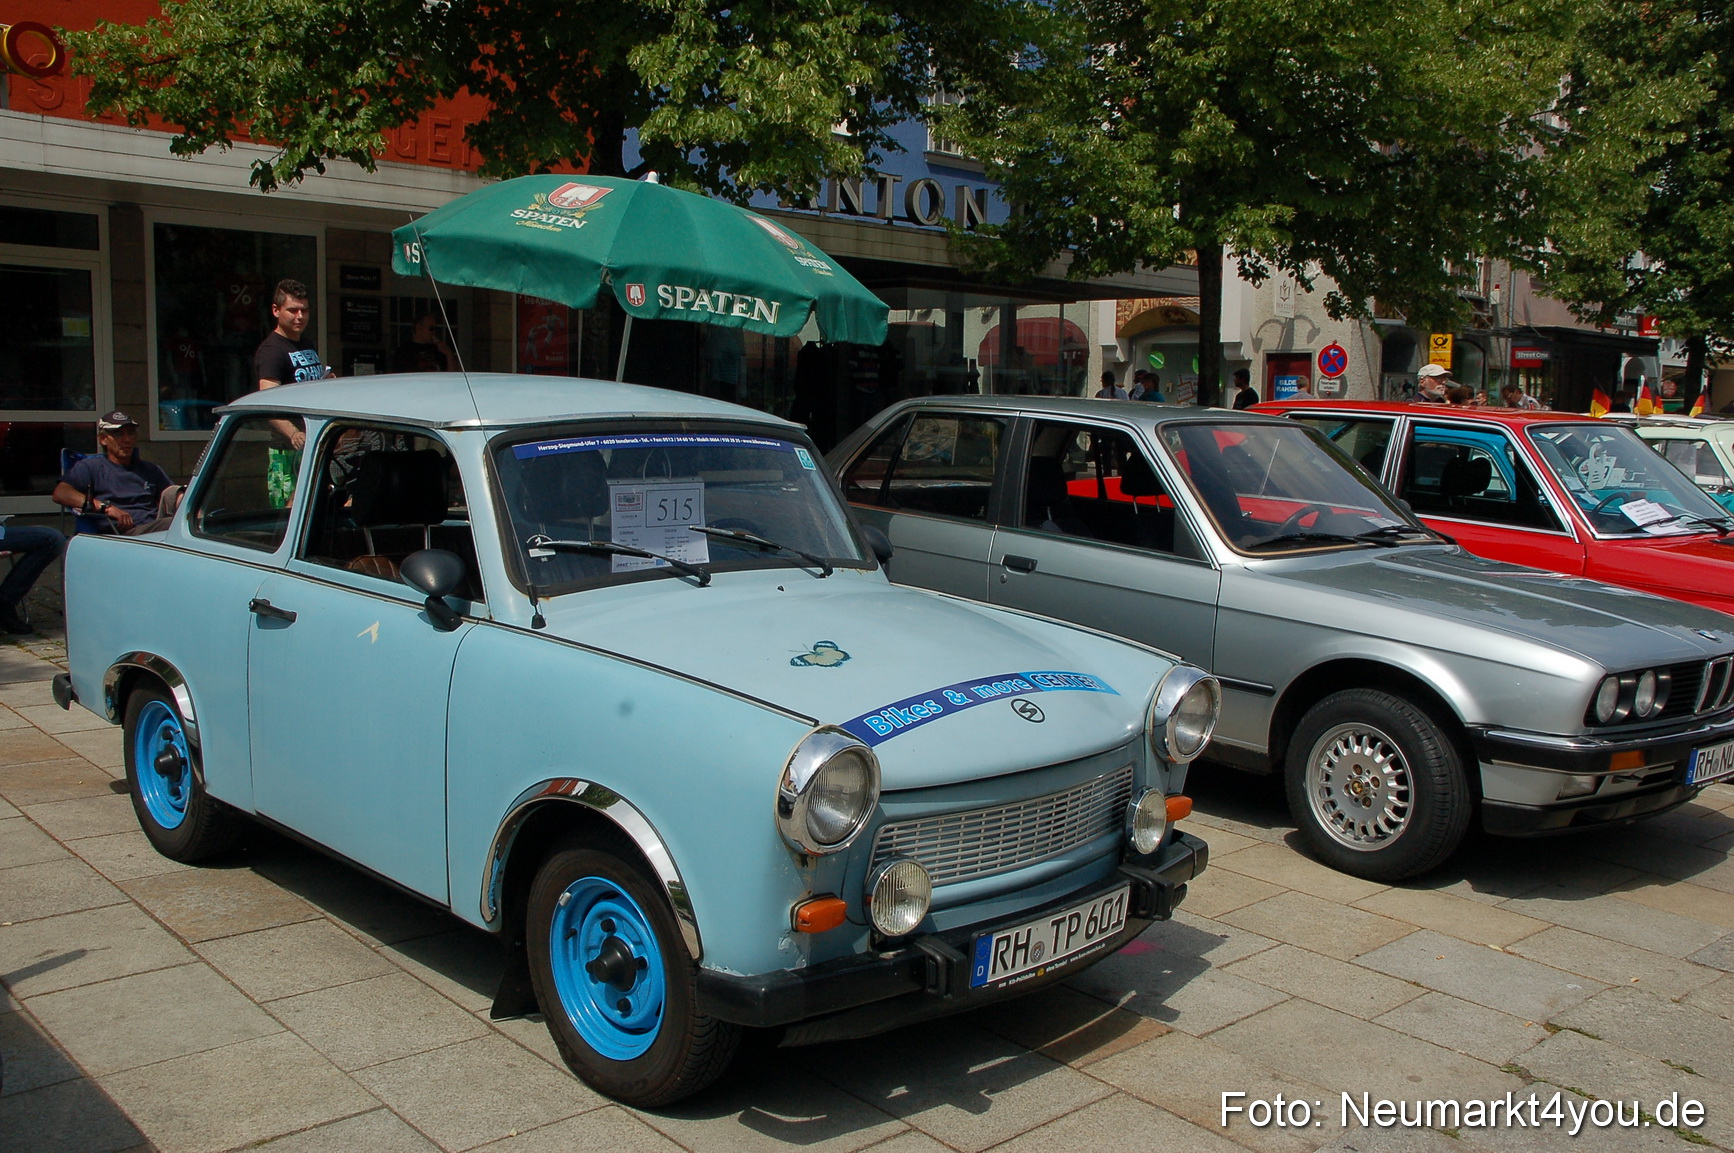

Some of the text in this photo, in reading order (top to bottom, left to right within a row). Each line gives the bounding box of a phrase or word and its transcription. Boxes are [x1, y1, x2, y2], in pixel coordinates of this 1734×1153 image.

[779, 172, 988, 229] NTON
[510, 209, 588, 229] SPATEN
[657, 284, 781, 325] SPATEN
[538, 441, 596, 451] Herzog-Siegmund-Ufer
[656, 497, 693, 522] 515
[863, 673, 1106, 737] Bikes & more CENTER
[1695, 749, 1716, 779] RH
[990, 892, 1125, 976] RH TP 601
[976, 965, 985, 977] D
